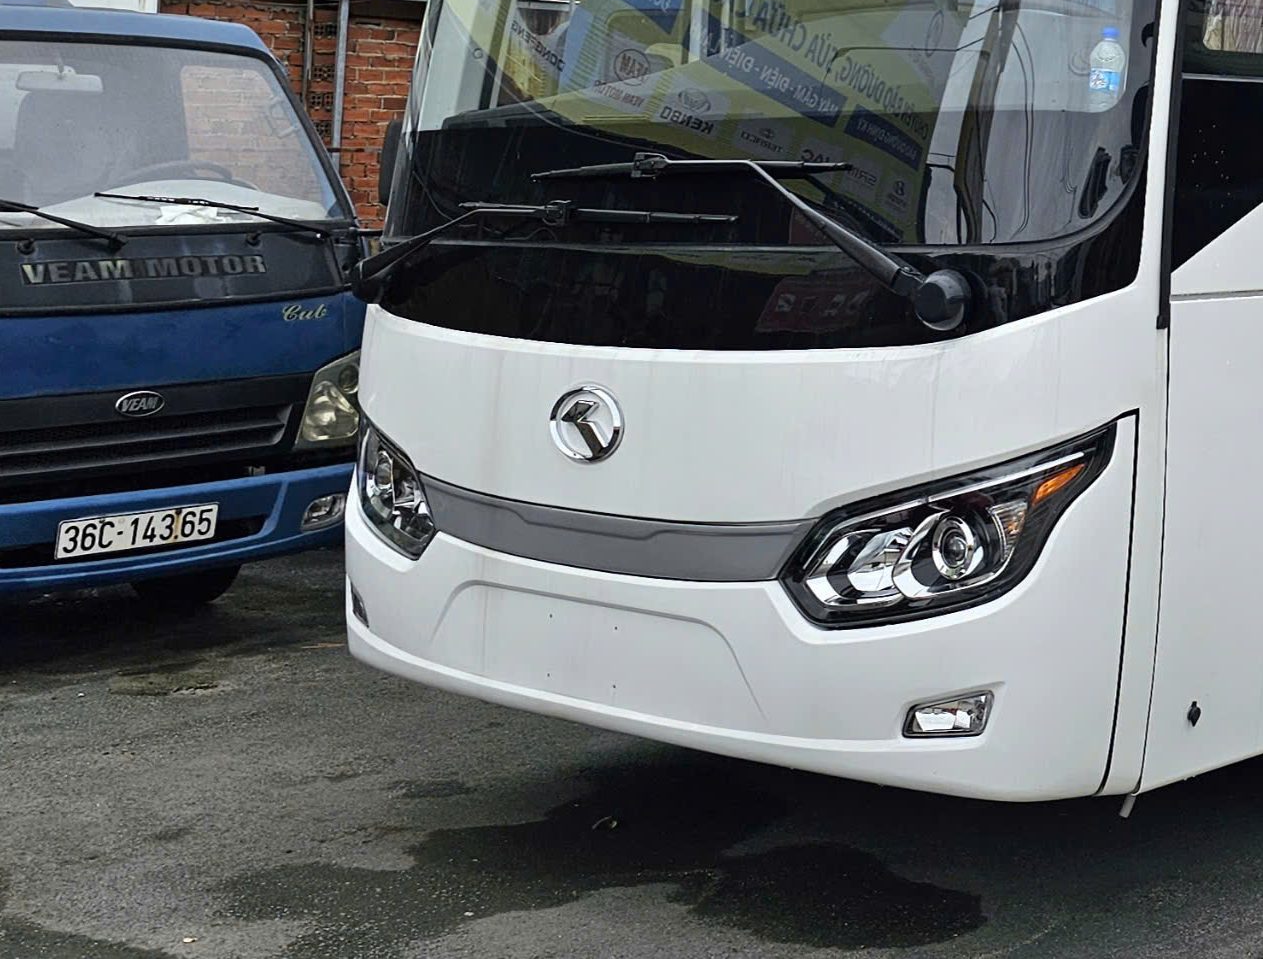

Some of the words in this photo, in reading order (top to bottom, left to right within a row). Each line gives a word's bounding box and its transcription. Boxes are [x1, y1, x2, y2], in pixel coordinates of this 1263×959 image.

[21, 258, 134, 285] VEAM
[149, 254, 266, 279] MOTOR
[281, 303, 328, 321] Cub
[120, 395, 159, 413] VEAM
[61, 507, 215, 554] 36C-143.65
